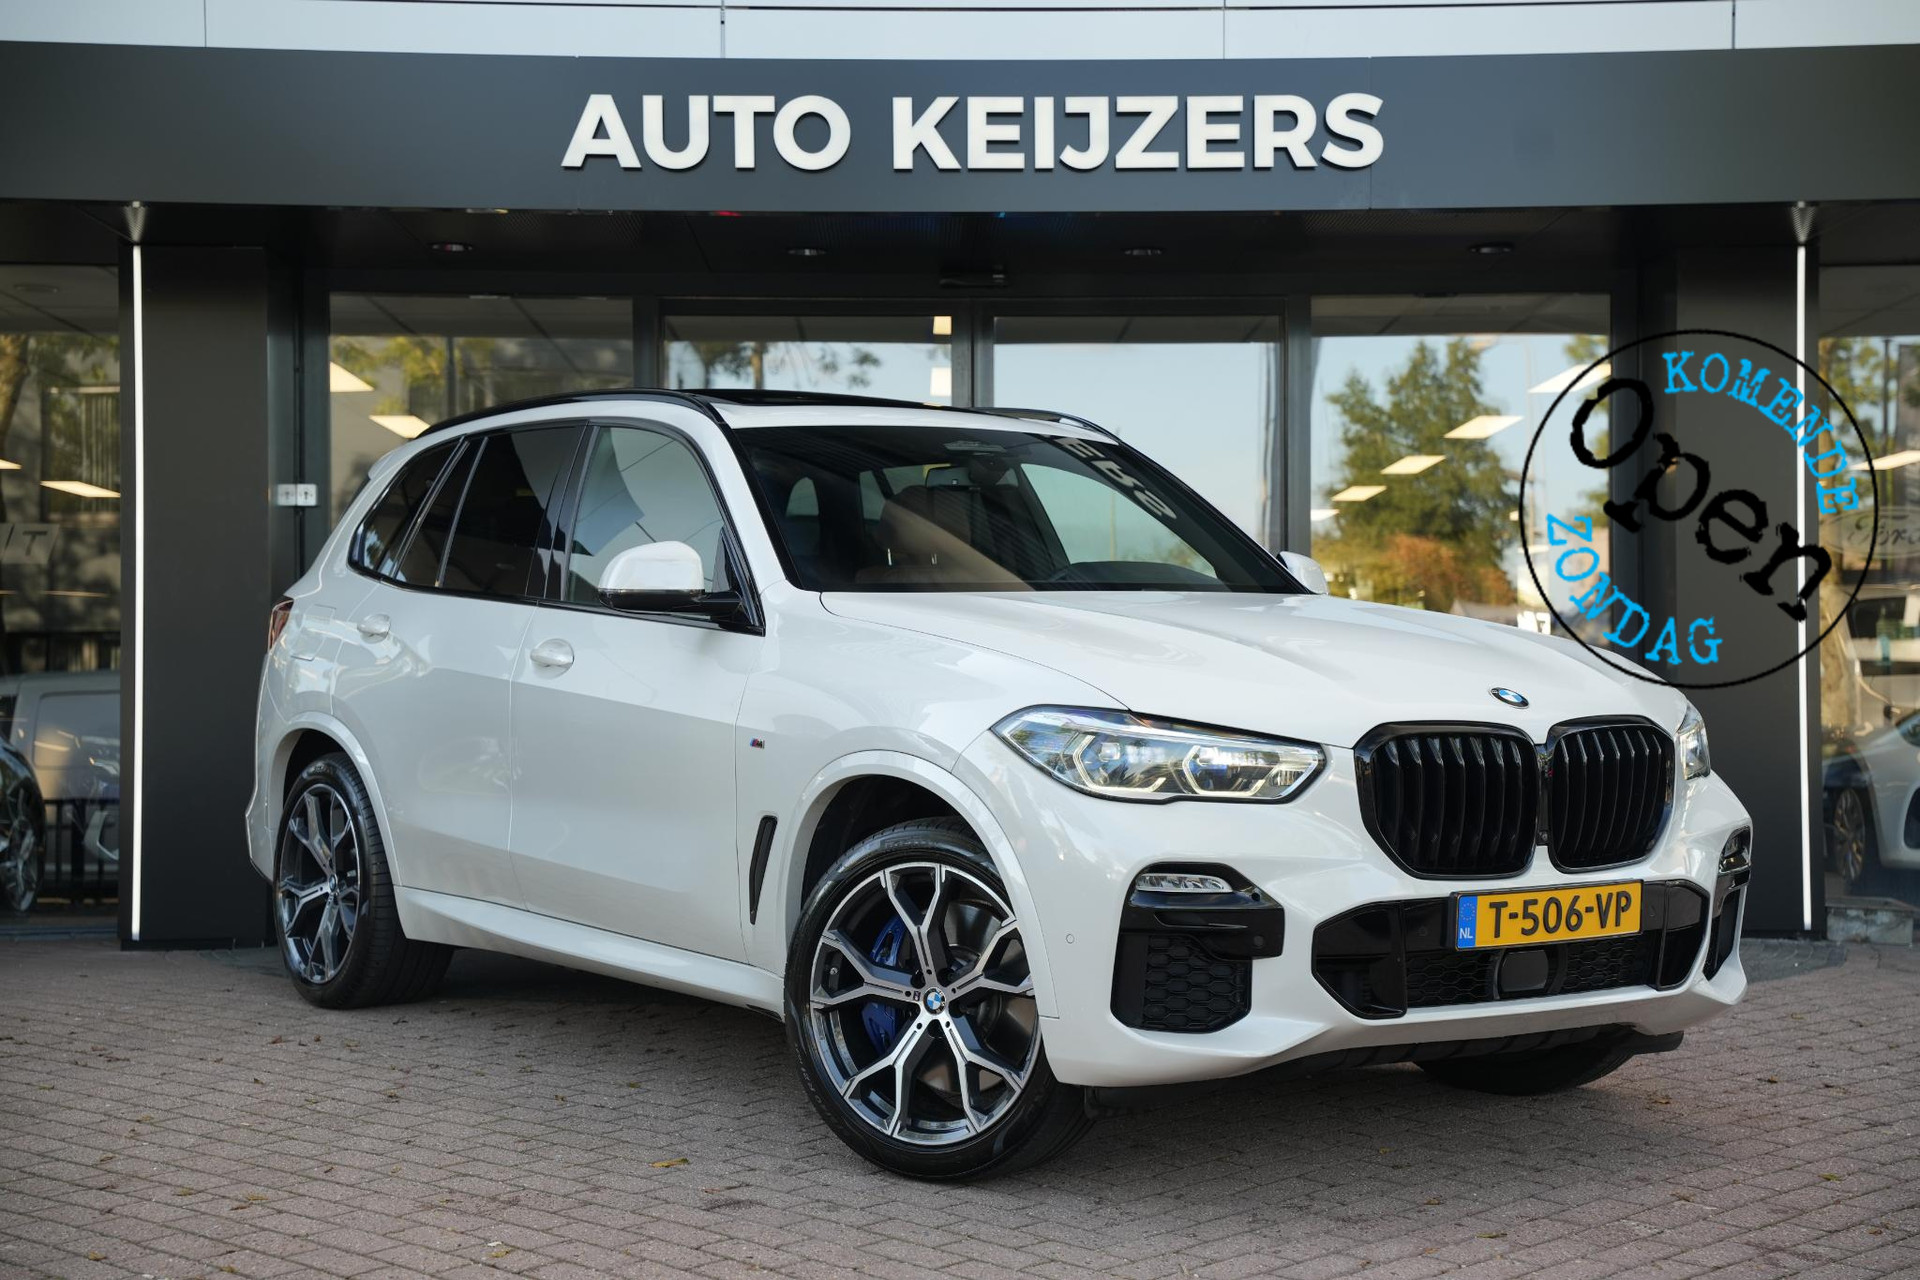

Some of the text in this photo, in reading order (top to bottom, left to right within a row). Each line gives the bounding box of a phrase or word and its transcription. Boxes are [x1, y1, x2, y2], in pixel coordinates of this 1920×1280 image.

[561, 92, 1384, 171] AUTO KEIJZERS
[1459, 927, 1474, 940] NL
[1489, 890, 1632, 939] T-506-VP
